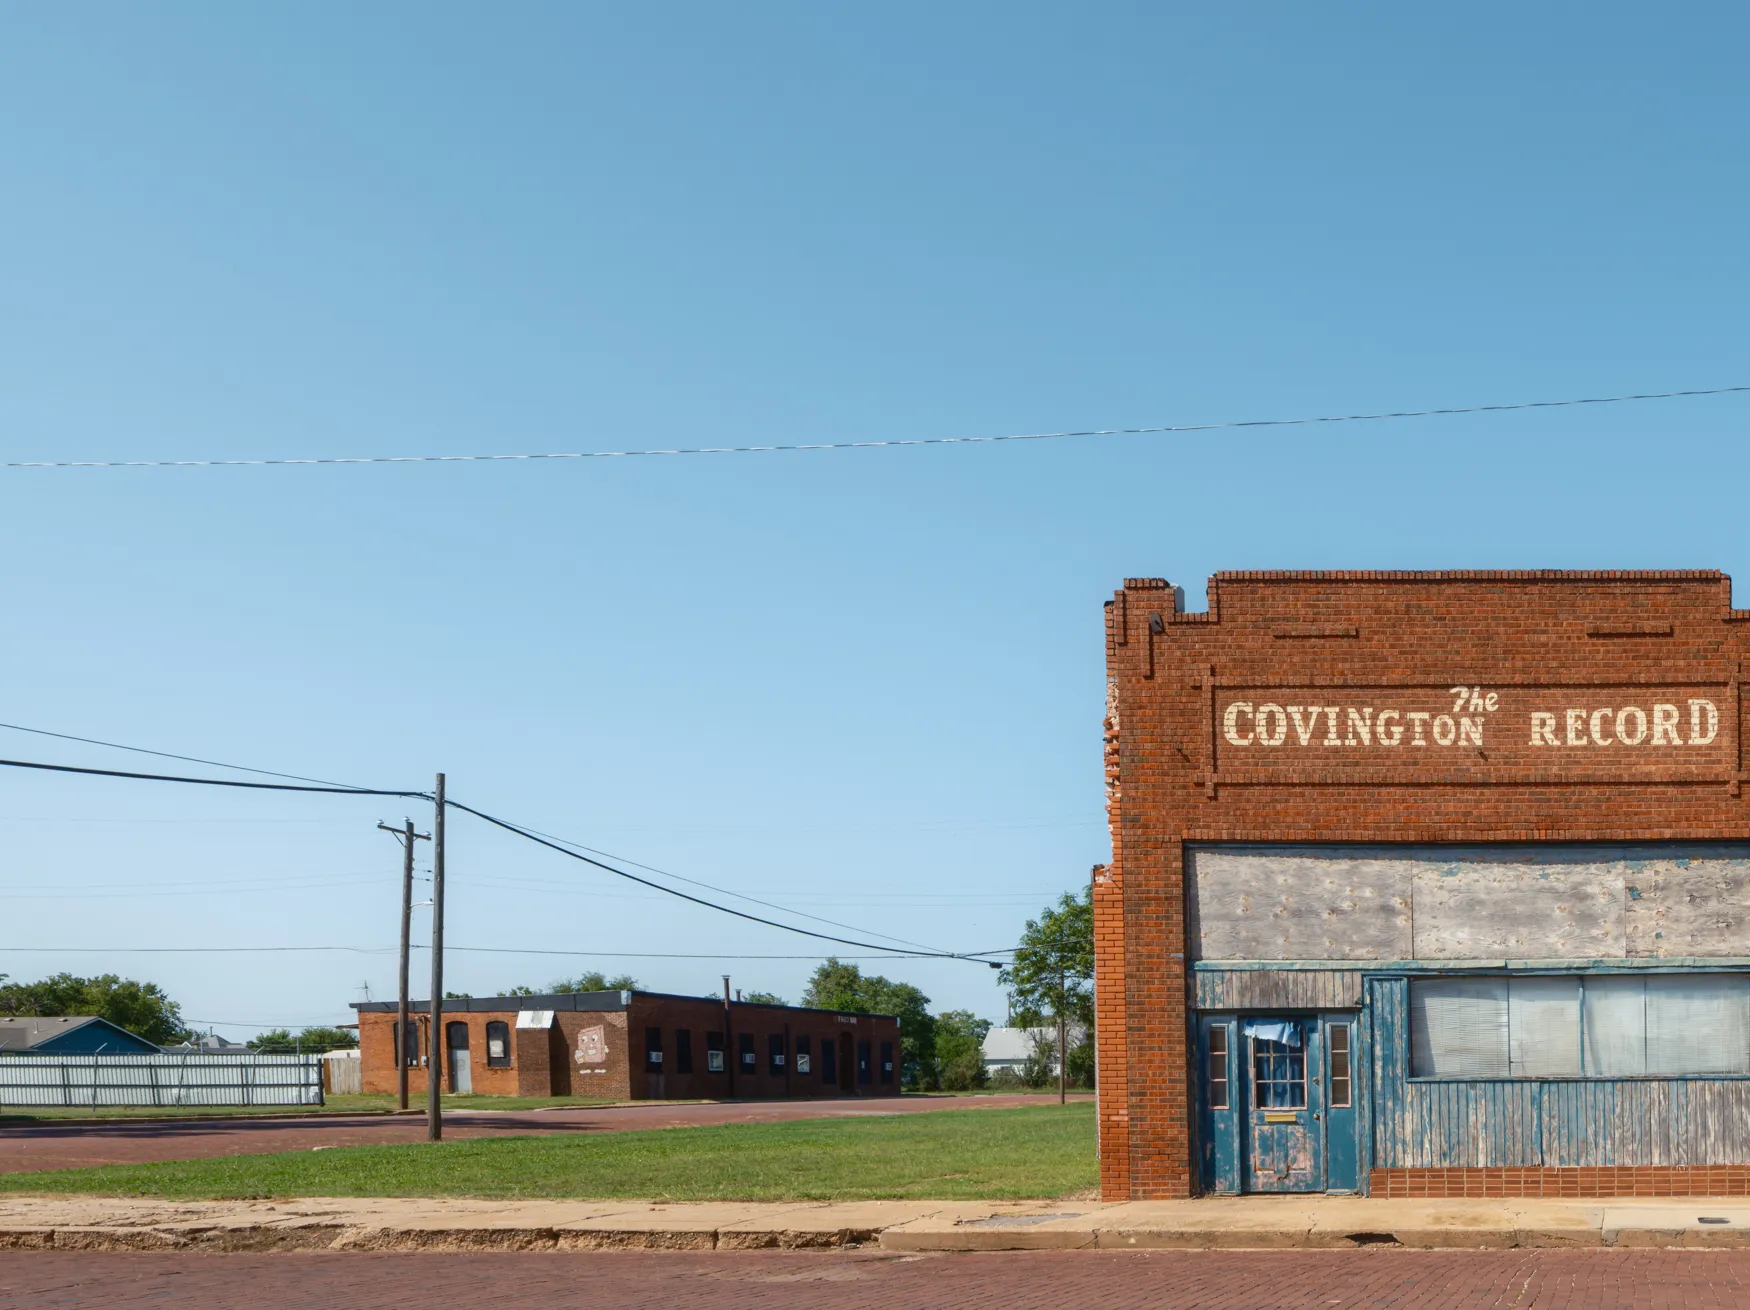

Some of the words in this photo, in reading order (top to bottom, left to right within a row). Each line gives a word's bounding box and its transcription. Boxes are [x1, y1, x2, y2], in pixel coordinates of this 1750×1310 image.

[1450, 687, 1498, 712] The
[1224, 702, 1483, 746] COVINGTON
[1529, 700, 1718, 746] RECORD
